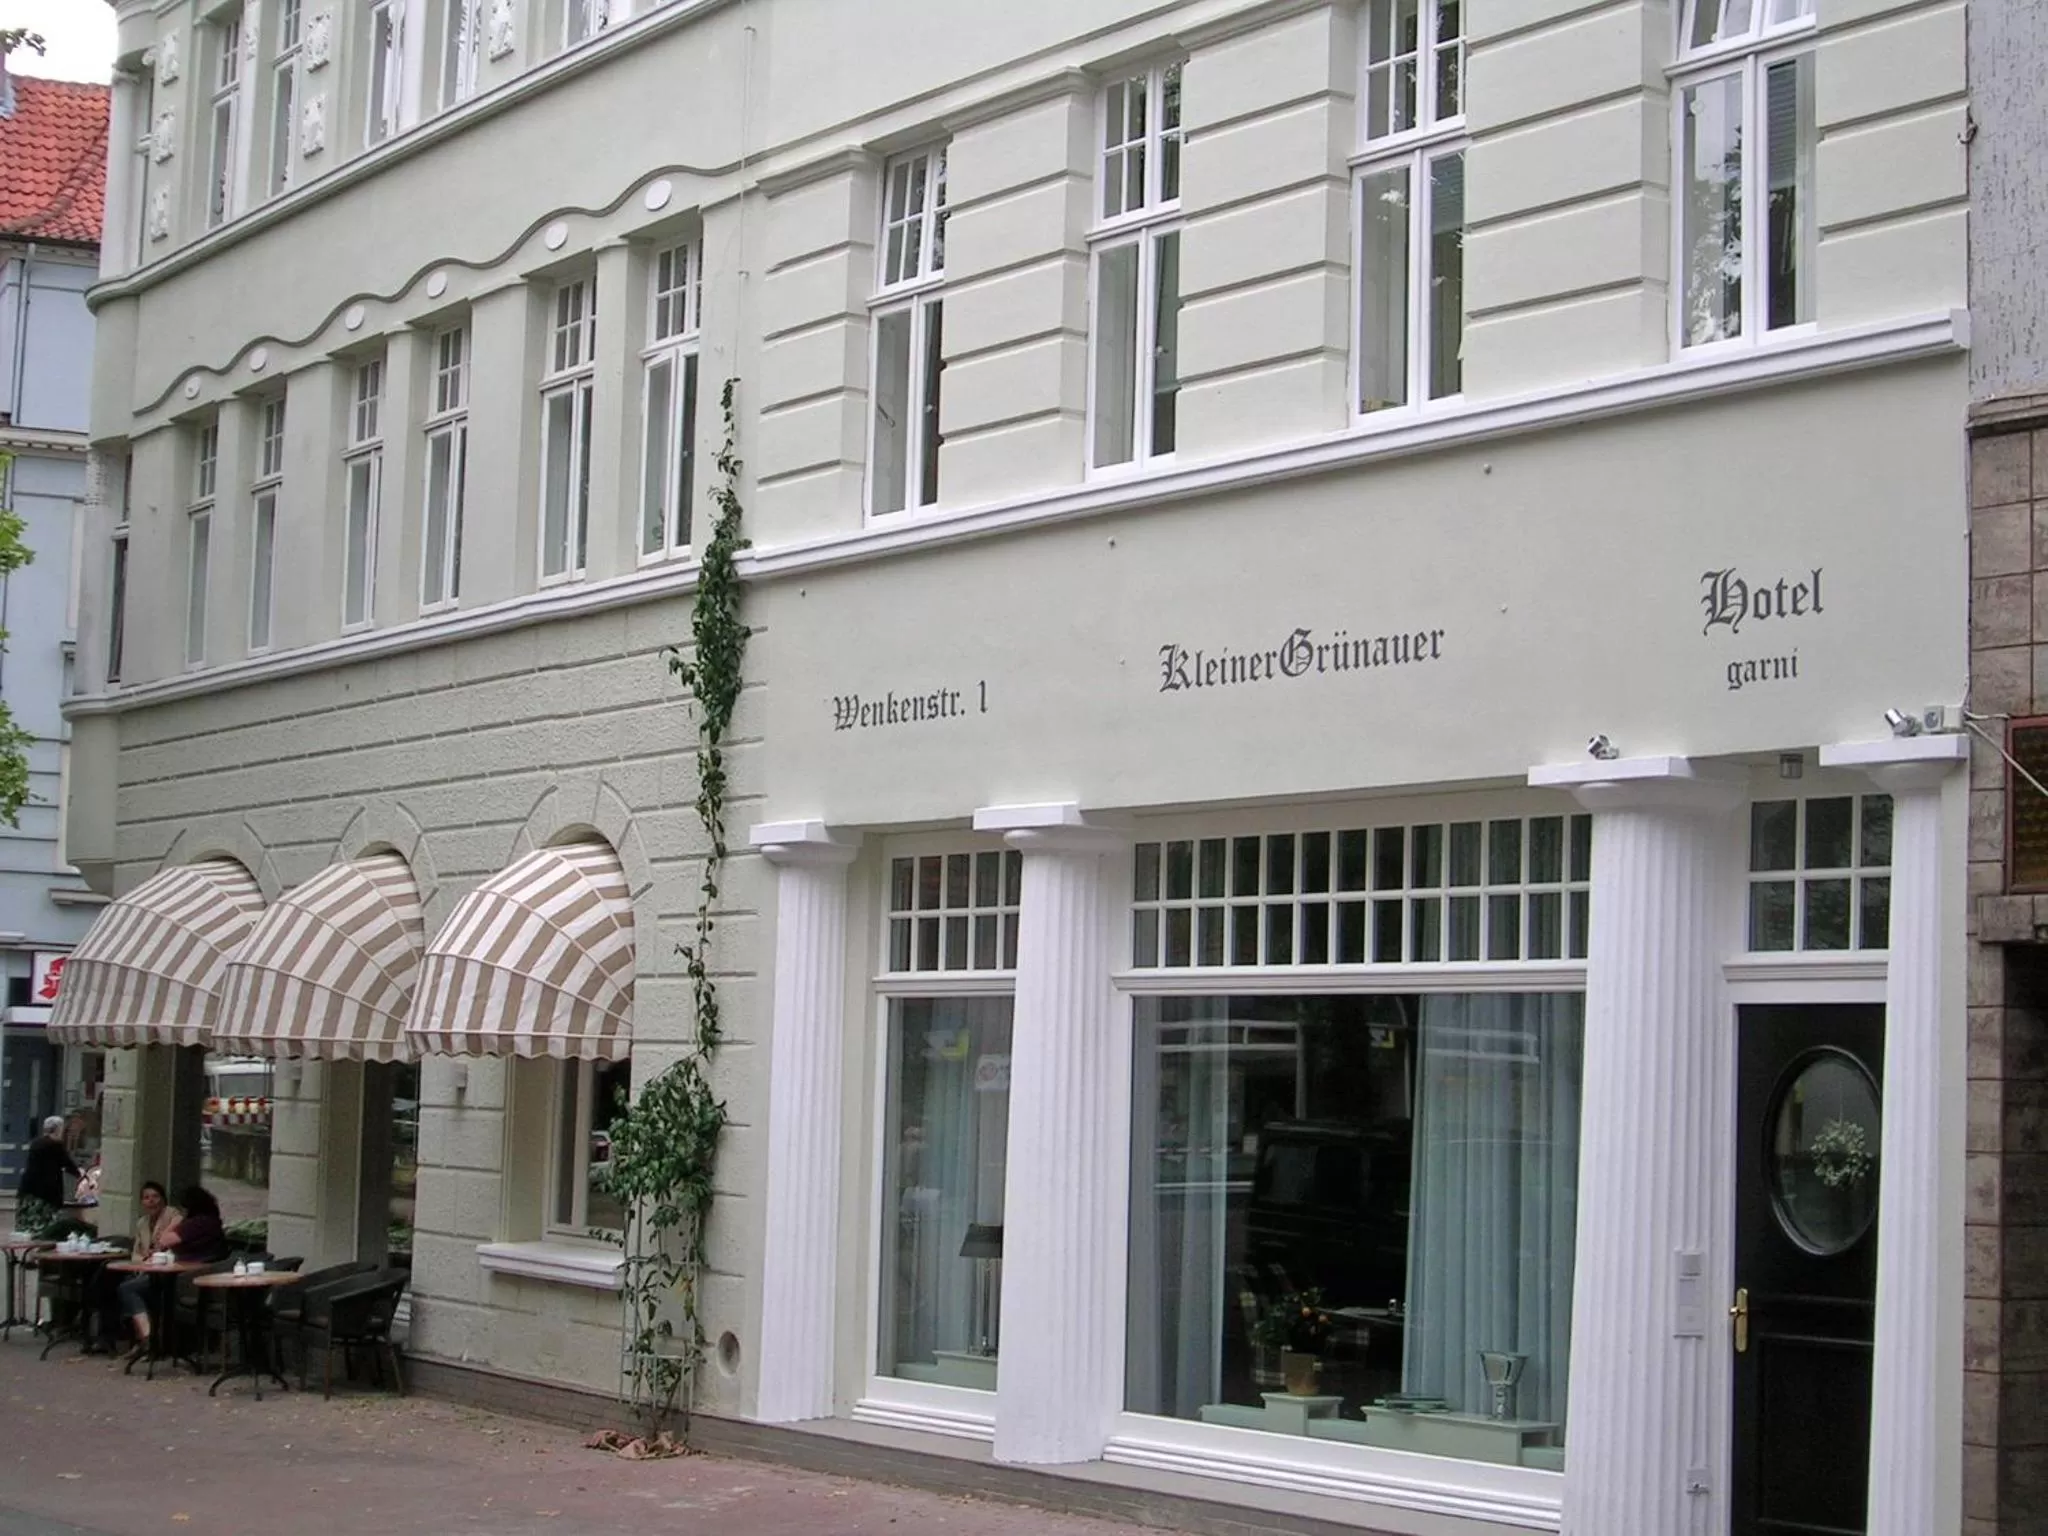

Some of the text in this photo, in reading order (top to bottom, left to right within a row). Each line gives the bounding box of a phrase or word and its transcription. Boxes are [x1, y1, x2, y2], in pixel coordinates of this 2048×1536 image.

[1701, 567, 1824, 636] Hotel
[1726, 648, 1800, 690] garni
[833, 680, 988, 731] Wenkenstr. 1
